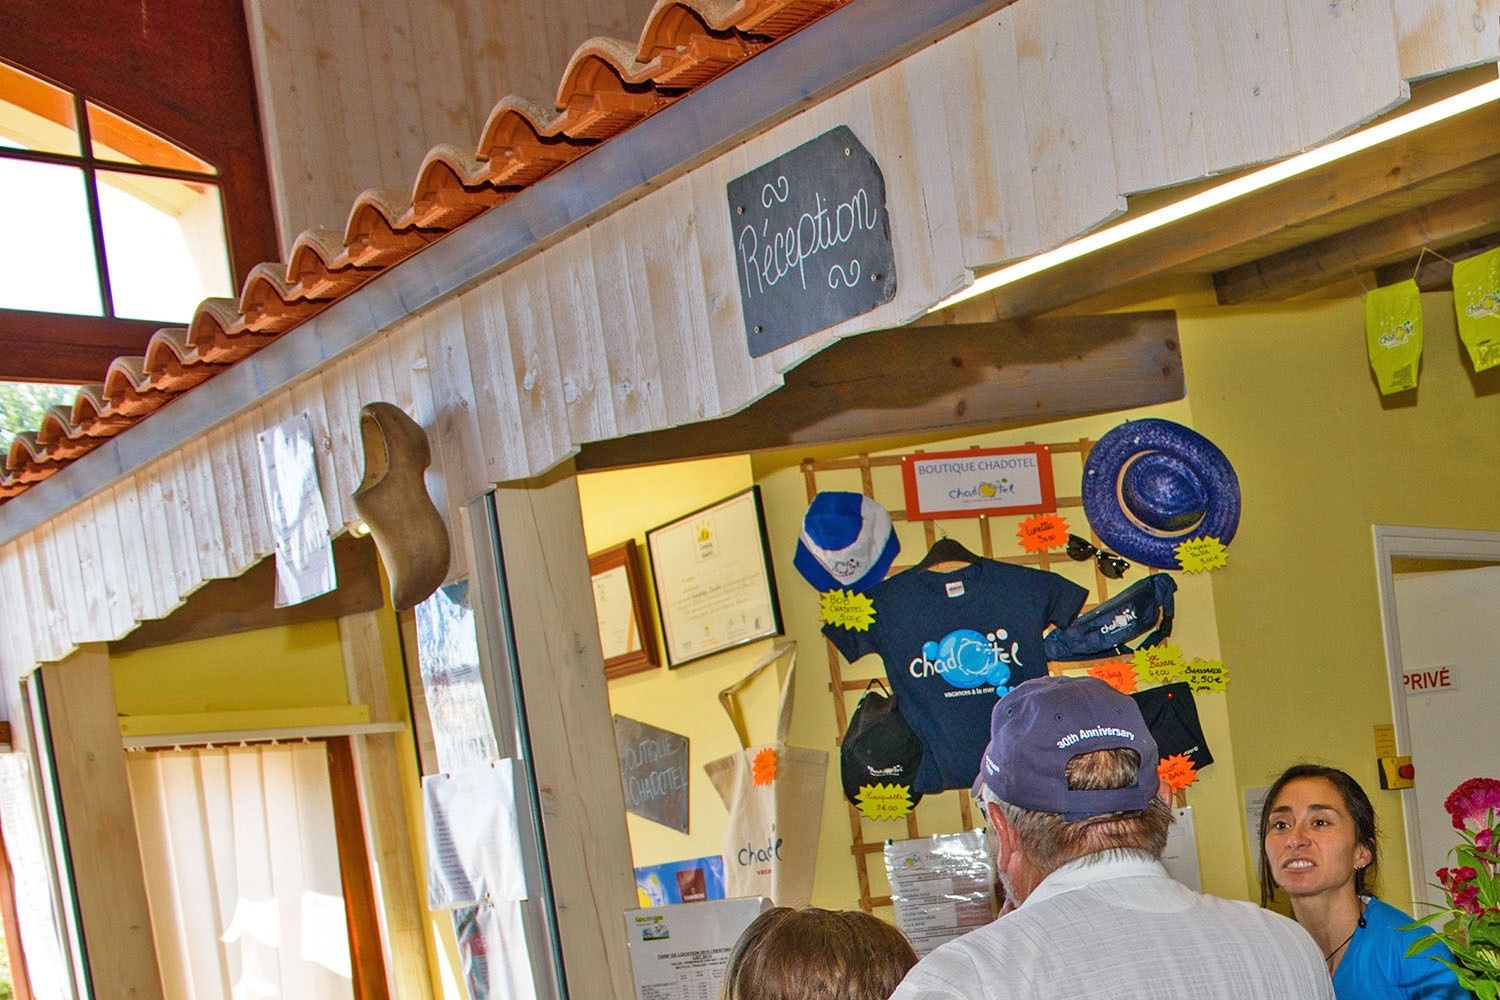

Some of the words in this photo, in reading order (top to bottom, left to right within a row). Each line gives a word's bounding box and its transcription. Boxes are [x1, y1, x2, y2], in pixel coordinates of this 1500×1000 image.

[739, 189, 877, 298] Réception
[919, 461, 976, 475] BOUTIQUE
[978, 458, 1035, 471] CHADOTEL
[1403, 667, 1451, 690] PRIVÉ
[1057, 734, 1079, 749] 30th
[1079, 725, 1134, 740] Anniversary
